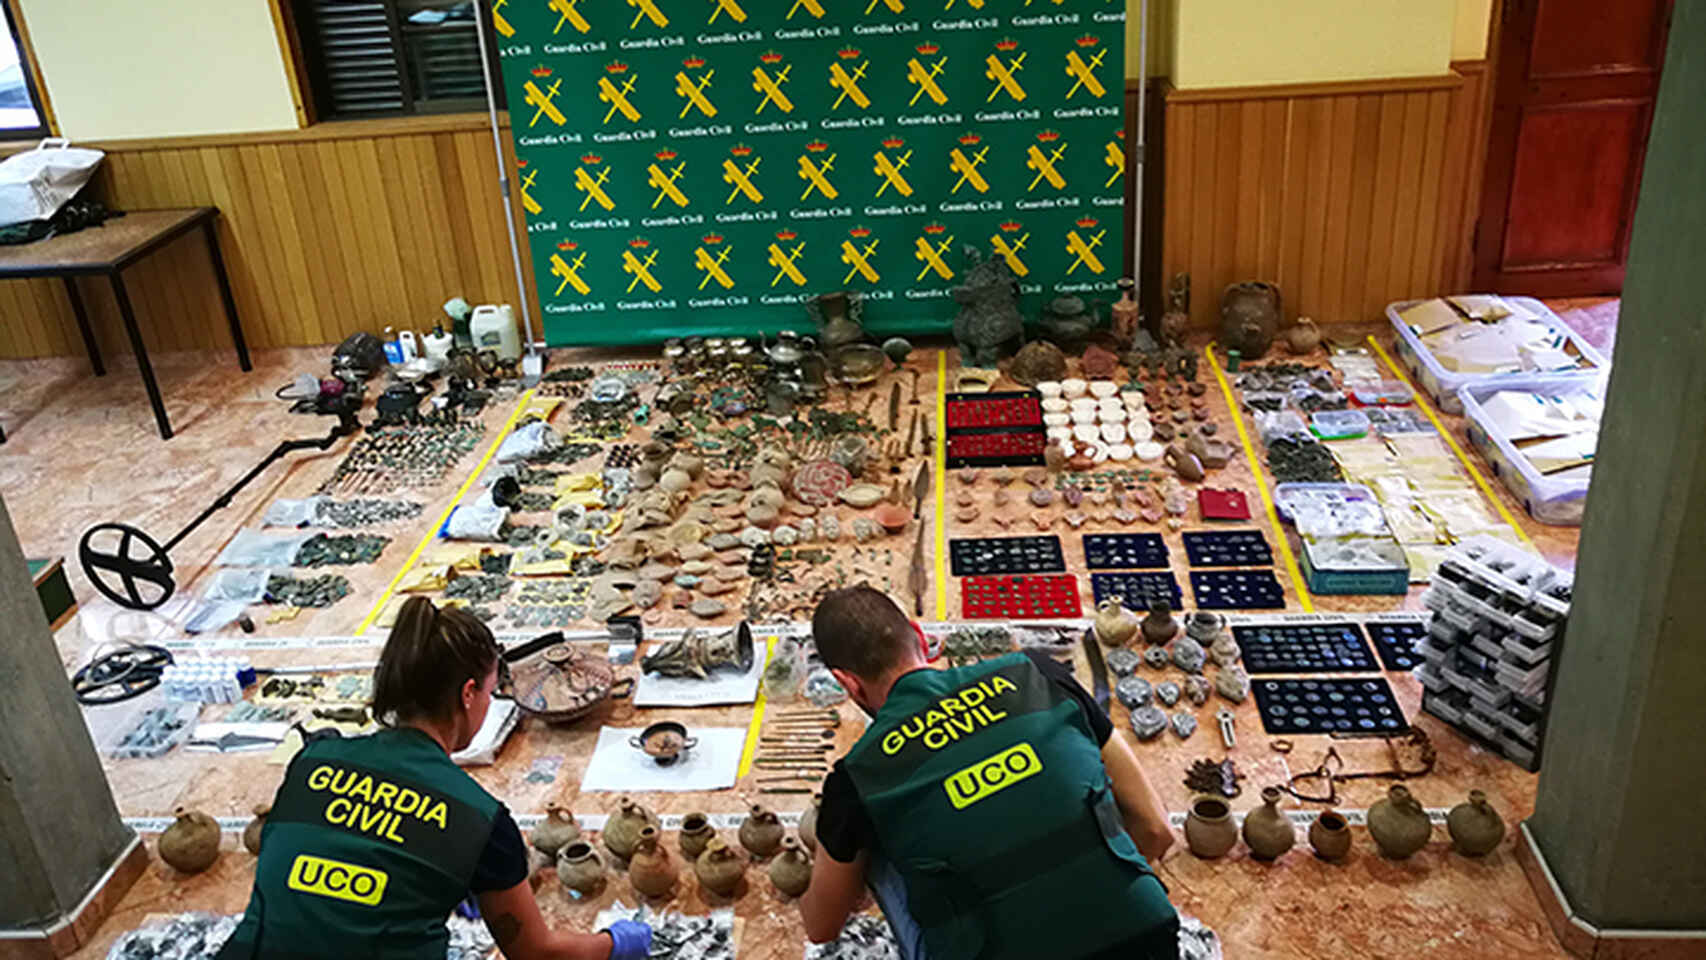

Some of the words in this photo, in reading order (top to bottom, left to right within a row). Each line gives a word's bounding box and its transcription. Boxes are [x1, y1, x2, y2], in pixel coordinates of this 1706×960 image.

[932, 19, 973, 30] Guardia
[975, 18, 999, 29] Civil
[1011, 15, 1053, 26] Guardia
[1055, 14, 1079, 25] Civil
[774, 28, 815, 39] Guardia
[817, 27, 840, 37] Civil
[852, 24, 894, 34] Guardia
[895, 22, 919, 32] Civil
[619, 38, 660, 49] Guardia
[661, 36, 685, 47] Civil
[696, 33, 738, 44] Guardia
[739, 31, 762, 41] Civil
[507, 44, 531, 56] Civil
[543, 43, 582, 54] Guardia
[583, 41, 607, 52] Civil
[974, 111, 1015, 121] Guardia
[1016, 109, 1040, 120] Civil
[1053, 107, 1094, 118] Guardia
[1095, 107, 1119, 116] Civil
[820, 118, 860, 129] Guardia
[862, 117, 885, 127] Civil
[897, 115, 937, 125] Guardia
[938, 114, 962, 124] Civil
[668, 127, 708, 138] Guardia
[709, 125, 732, 136] Civil
[744, 122, 784, 134] Guardia
[785, 121, 808, 131] Civil
[519, 135, 559, 146] Guardia
[559, 134, 582, 143] Civil
[593, 132, 632, 143] Guardia
[633, 129, 657, 141] Civil
[939, 202, 979, 212] Guardia
[980, 201, 1003, 211] Civil
[1015, 199, 1055, 210] Guardia
[1056, 197, 1080, 207] Civil
[789, 209, 828, 219] Guardia
[829, 207, 852, 217] Civil
[864, 205, 903, 216] Guardia
[904, 204, 927, 214] Civil
[641, 216, 681, 227] Guardia
[681, 214, 704, 225] Civil
[715, 212, 754, 223] Guardia
[756, 211, 778, 221] Civil
[535, 221, 557, 232] Civil
[569, 219, 608, 229] Guardia
[608, 219, 630, 228] Civil
[1054, 281, 1093, 292] Guardia
[759, 294, 798, 304] Guardia
[871, 290, 893, 300] Civil
[905, 289, 943, 299] Guardia
[545, 303, 583, 313] Guardia
[583, 302, 605, 311] Civil
[616, 300, 654, 310] Guardia
[655, 300, 677, 309] Civil
[688, 297, 726, 308] Guardia
[727, 296, 749, 306] Civil
[881, 675, 1018, 756] GUARDIA
[922, 703, 1008, 750] CIVIL
[952, 750, 1031, 799] UCO
[308, 765, 449, 830] GUARDIA
[325, 798, 405, 844] CIVIL
[297, 860, 378, 898] UCO
